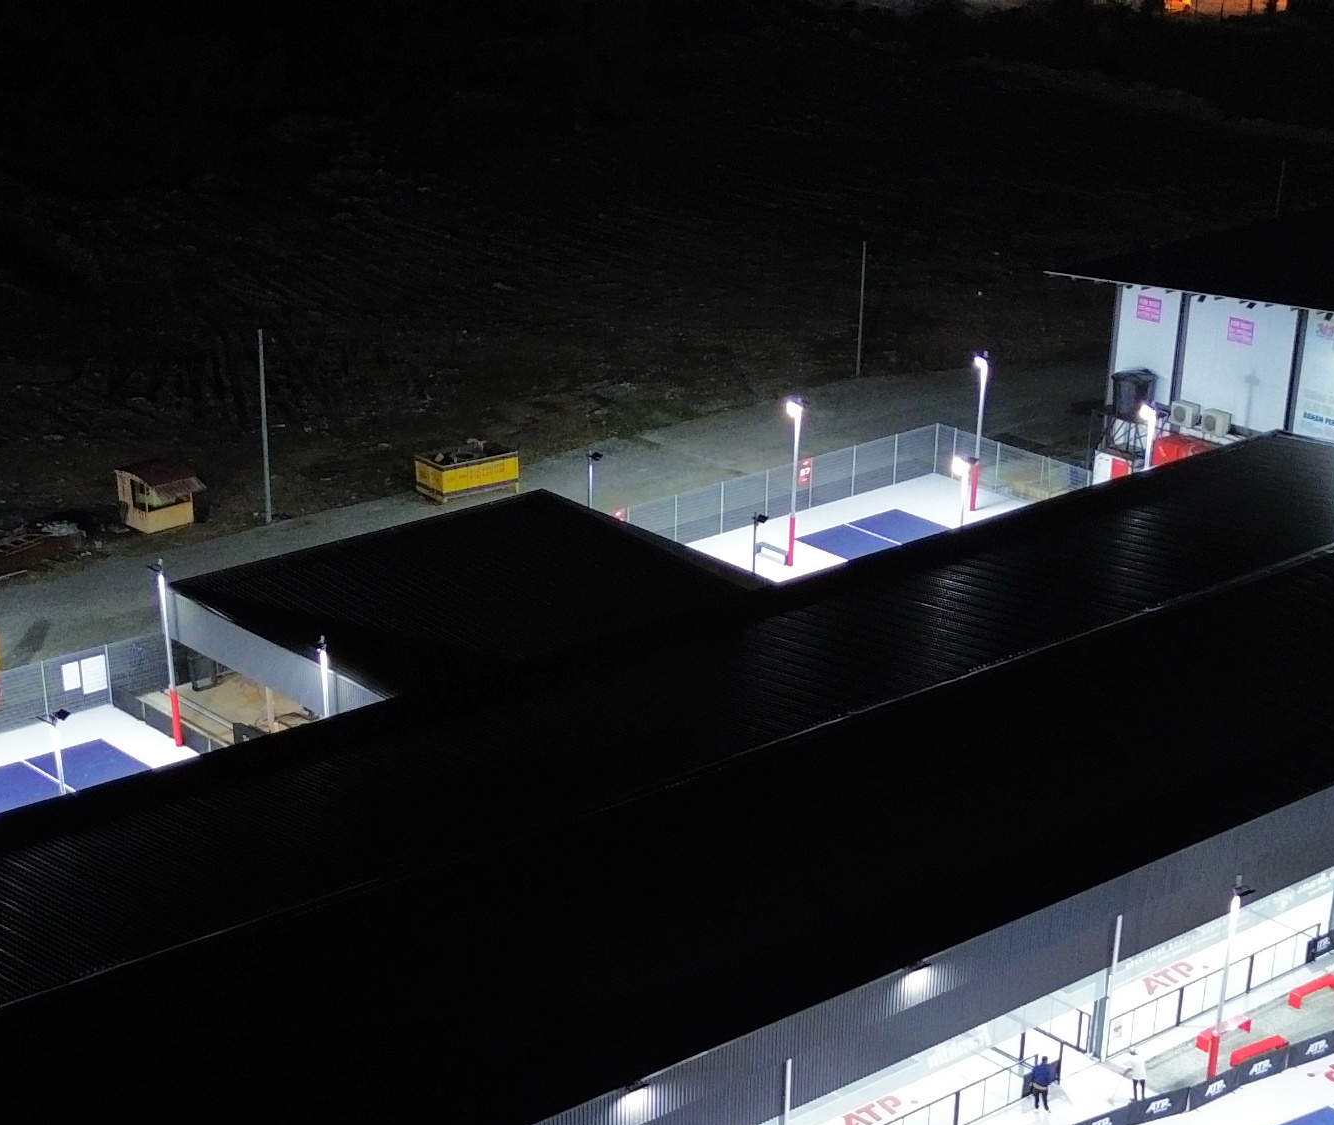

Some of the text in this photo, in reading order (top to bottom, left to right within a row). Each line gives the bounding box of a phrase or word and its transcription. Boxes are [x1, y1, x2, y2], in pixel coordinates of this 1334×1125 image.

[1142, 961, 1194, 996] ATP
[1249, 1058, 1271, 1076] ATP
[1205, 1079, 1225, 1097] ATP
[1145, 1098, 1170, 1114] ATP
